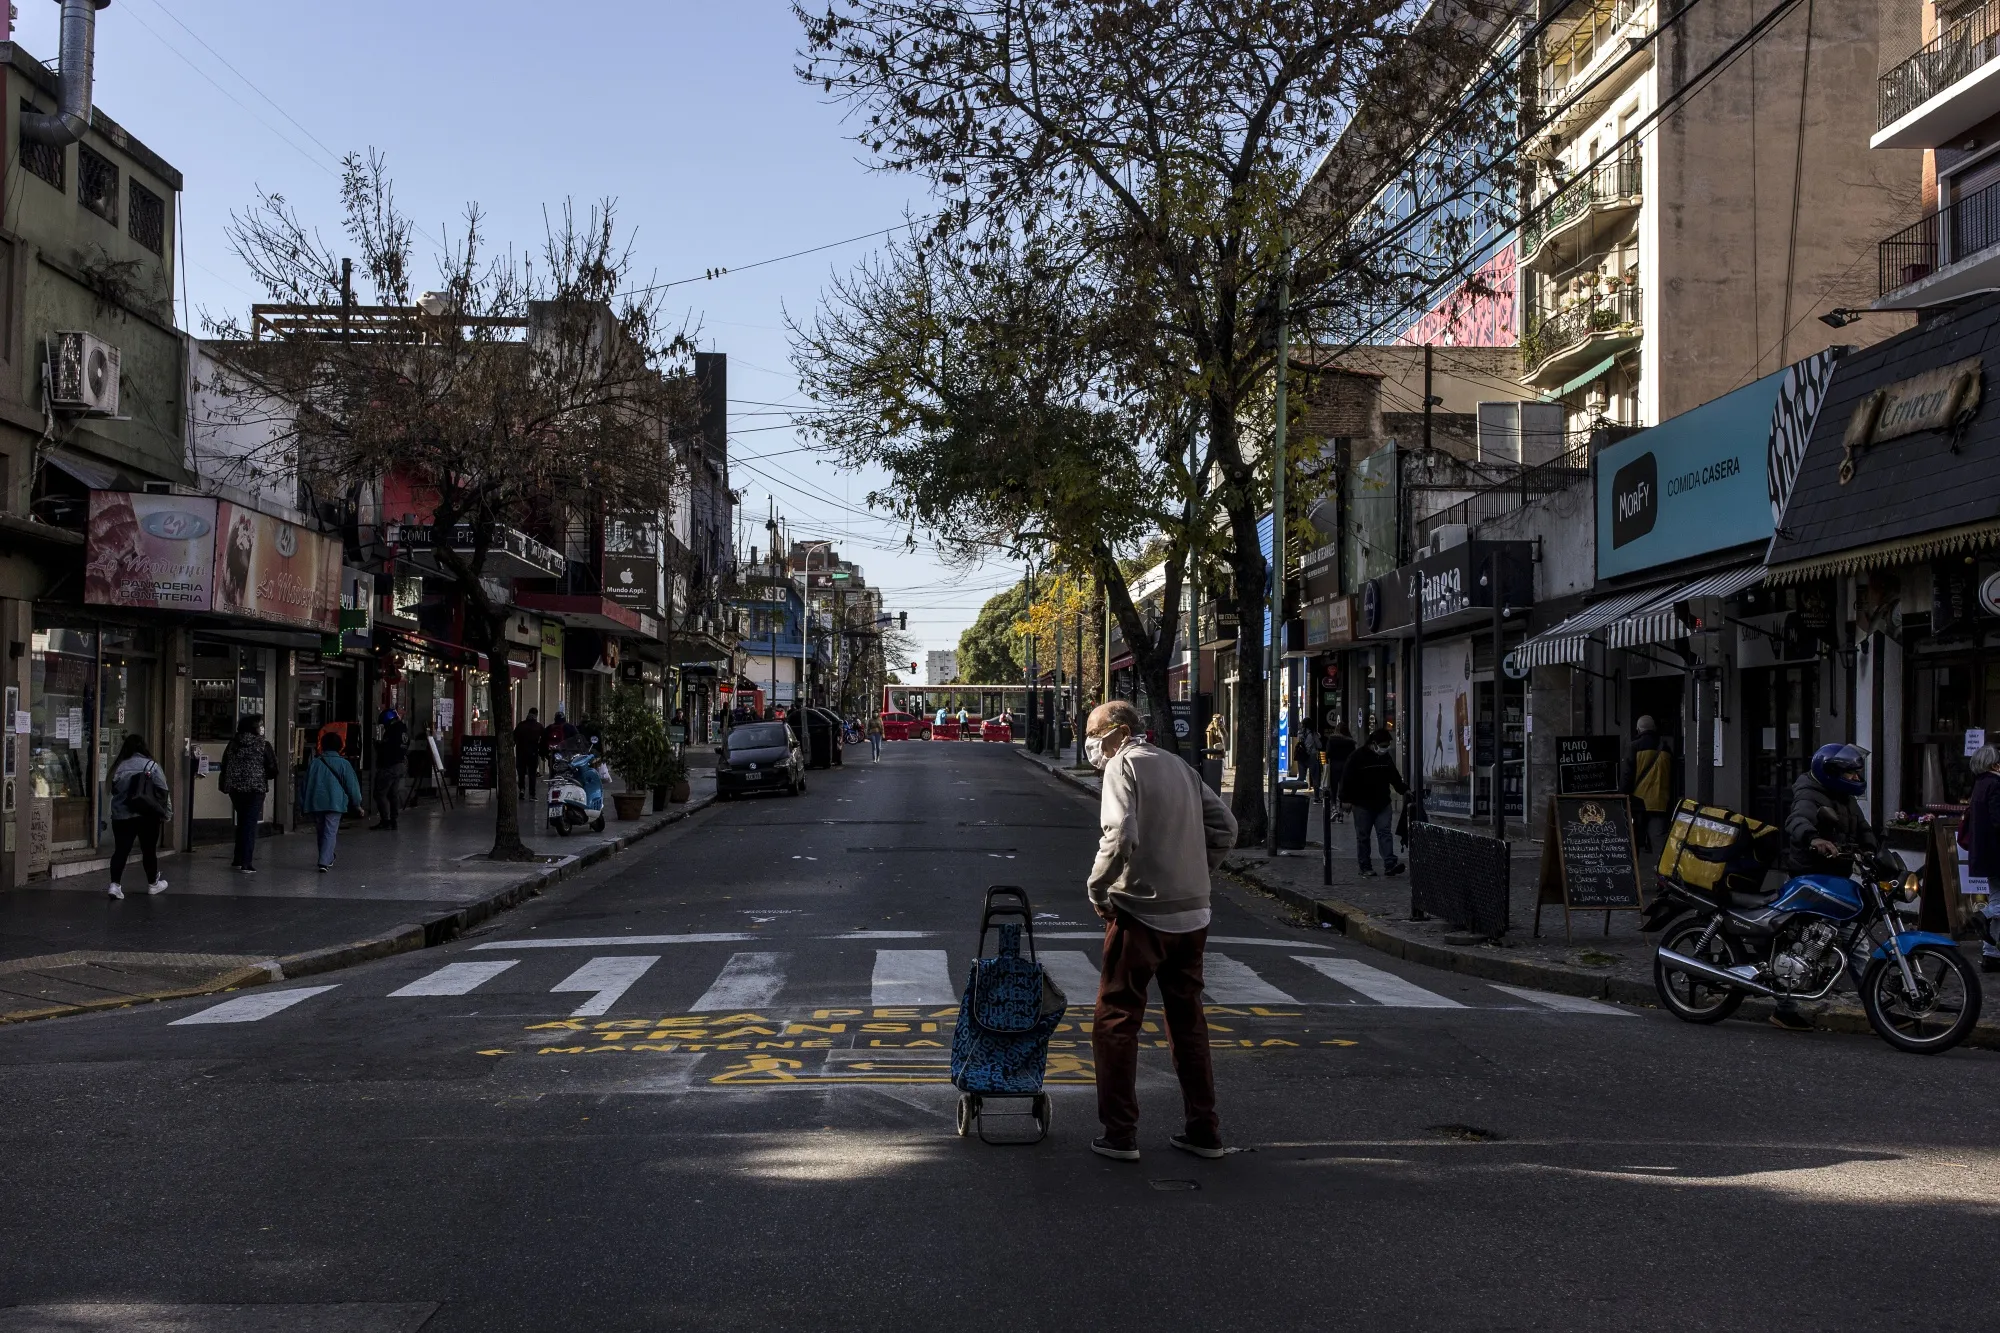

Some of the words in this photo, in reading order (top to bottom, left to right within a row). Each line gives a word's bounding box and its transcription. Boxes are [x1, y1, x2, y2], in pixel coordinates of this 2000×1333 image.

[1667, 470, 1701, 497] COMIDA
[1702, 456, 1740, 485] CASERA
[86, 553, 118, 571] La
[123, 551, 208, 577] Moderna
[120, 579, 204, 592] PANADERIA
[606, 586, 629, 594] Mundo
[120, 590, 204, 603] CONFITERIA
[1562, 740, 1588, 752] PLATO
[1560, 753, 1574, 763] del
[1577, 749, 1593, 762] DÍA
[523, 1012, 769, 1030] ÁREA
[537, 1037, 833, 1055] MANTENÉ
[869, 1039, 945, 1047] LA
